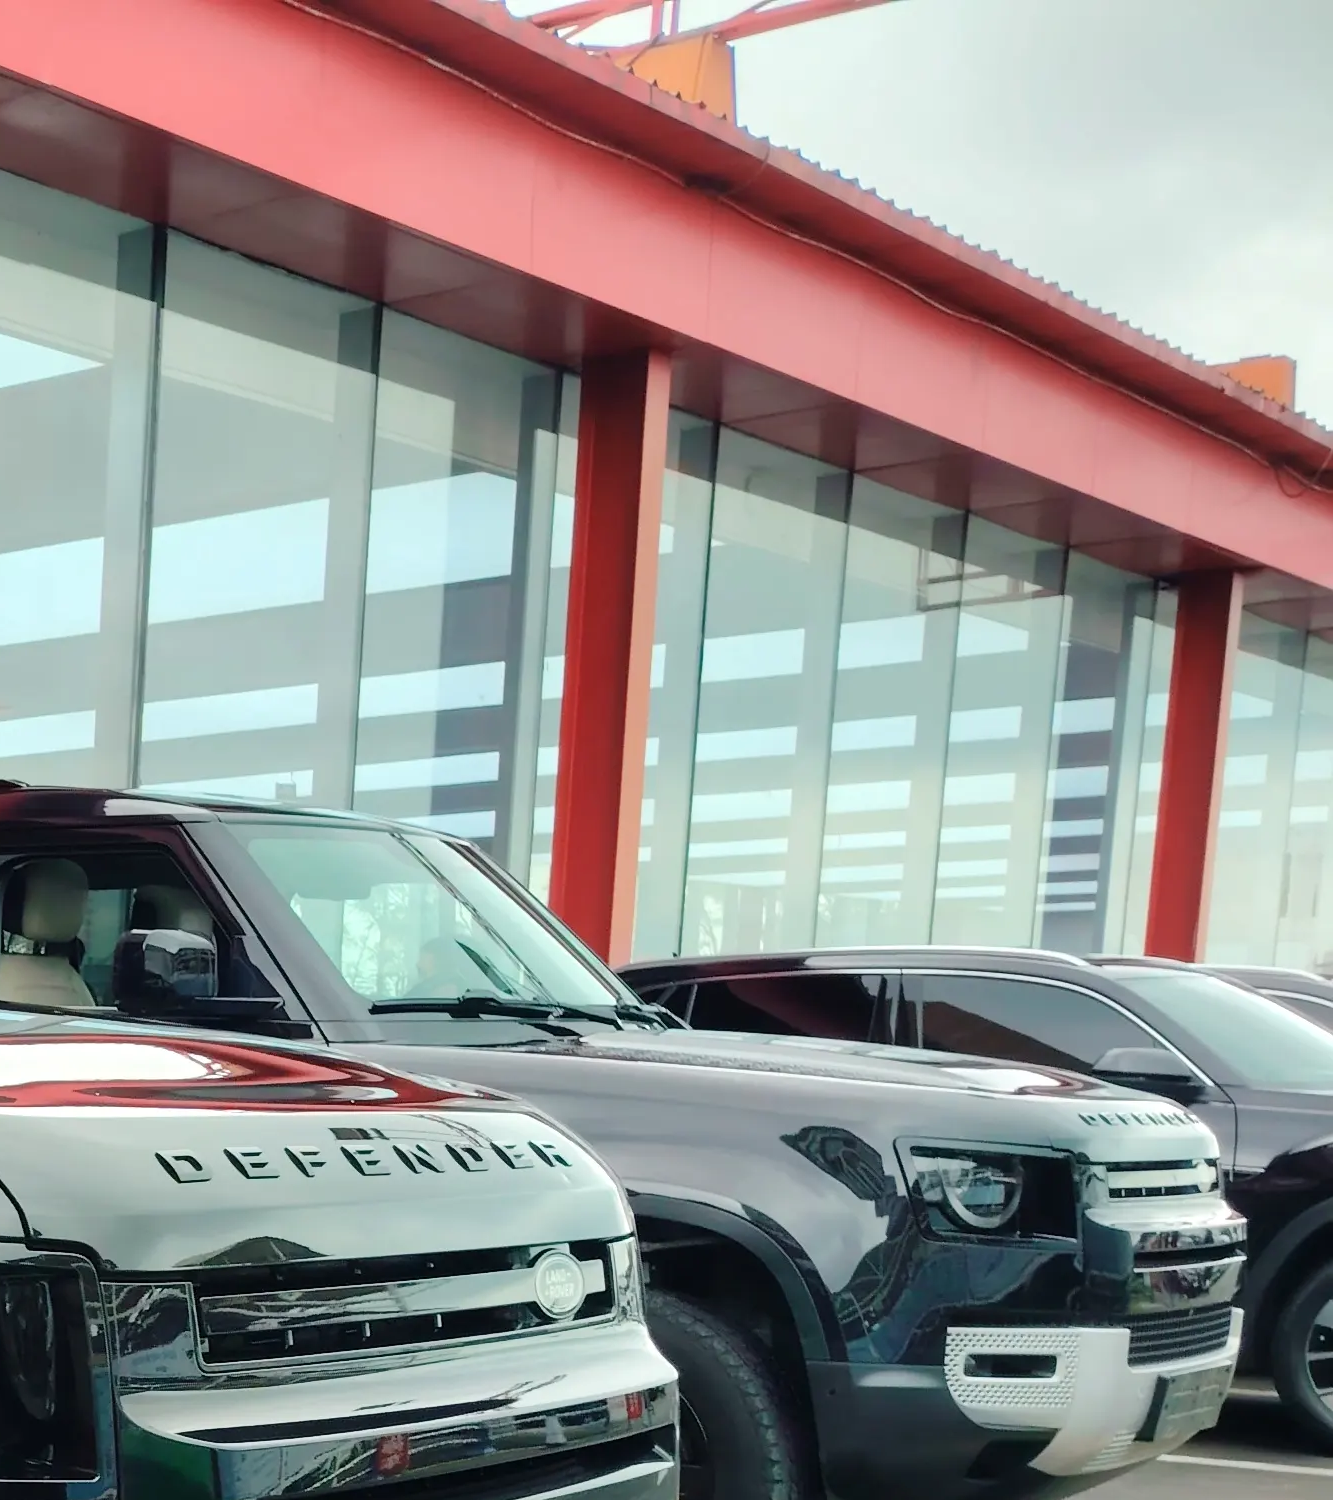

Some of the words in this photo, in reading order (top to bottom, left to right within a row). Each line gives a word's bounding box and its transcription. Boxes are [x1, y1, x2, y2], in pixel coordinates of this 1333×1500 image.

[154, 1139, 573, 1184] DEFENDER
[545, 1268, 567, 1285] LAND
[549, 1282, 575, 1299] ROVER
